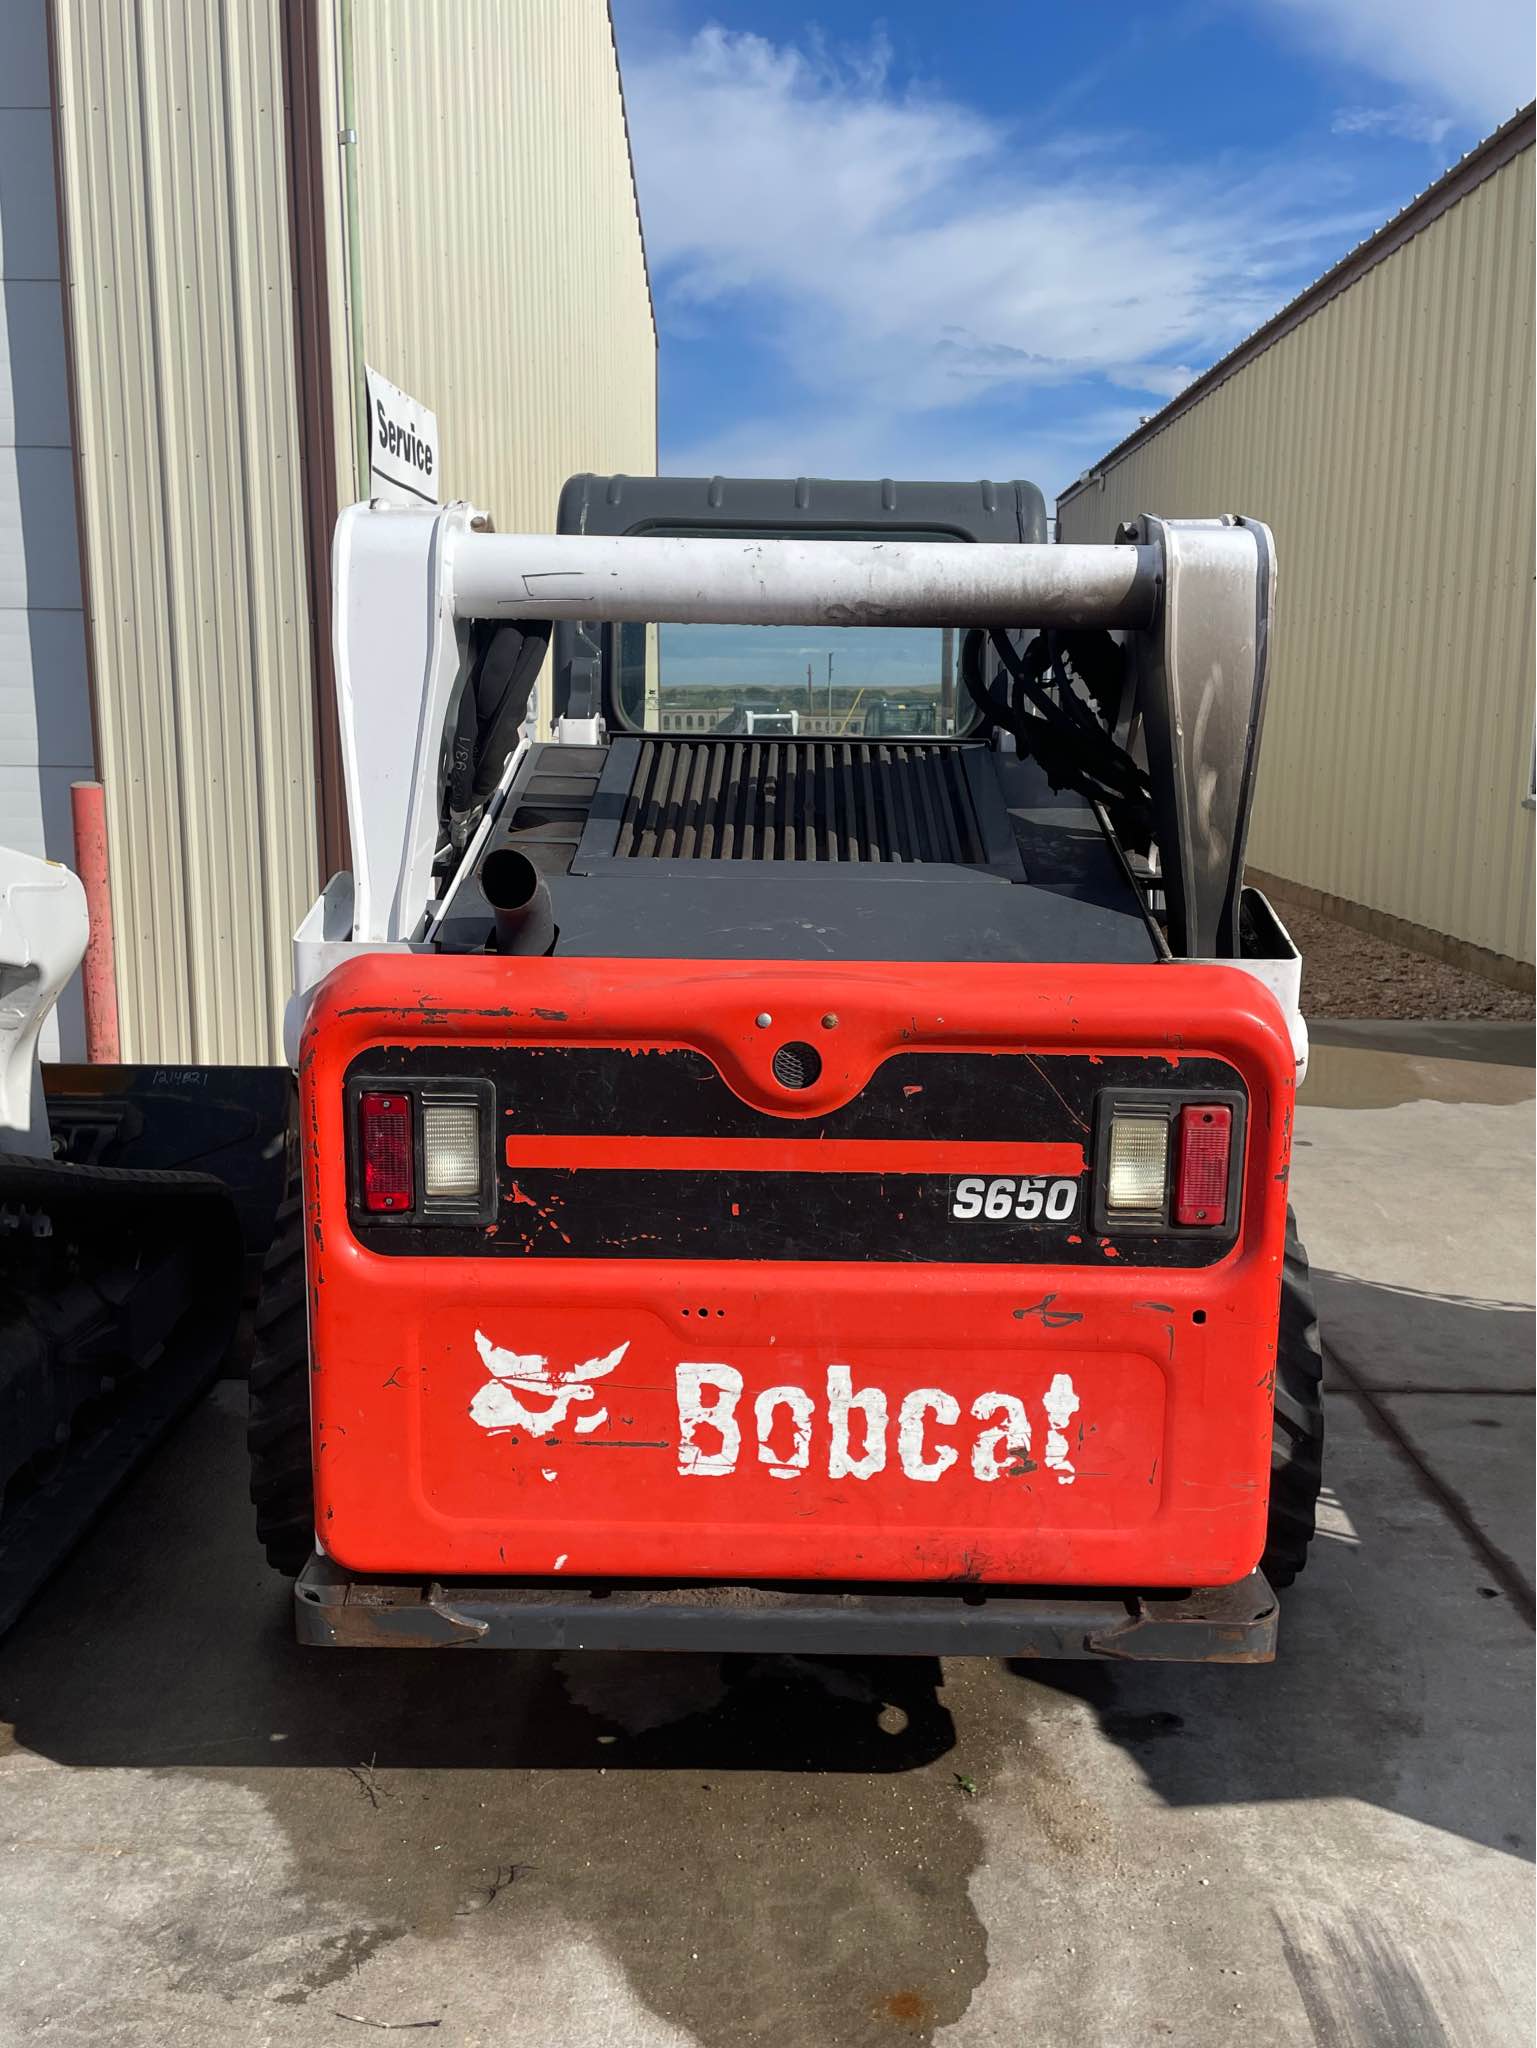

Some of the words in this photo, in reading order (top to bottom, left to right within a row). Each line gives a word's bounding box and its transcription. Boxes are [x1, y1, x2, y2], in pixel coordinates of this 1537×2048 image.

[376, 399, 433, 476] Service
[952, 1178, 1078, 1221] S650
[676, 1362, 1081, 1486] Bobcat
